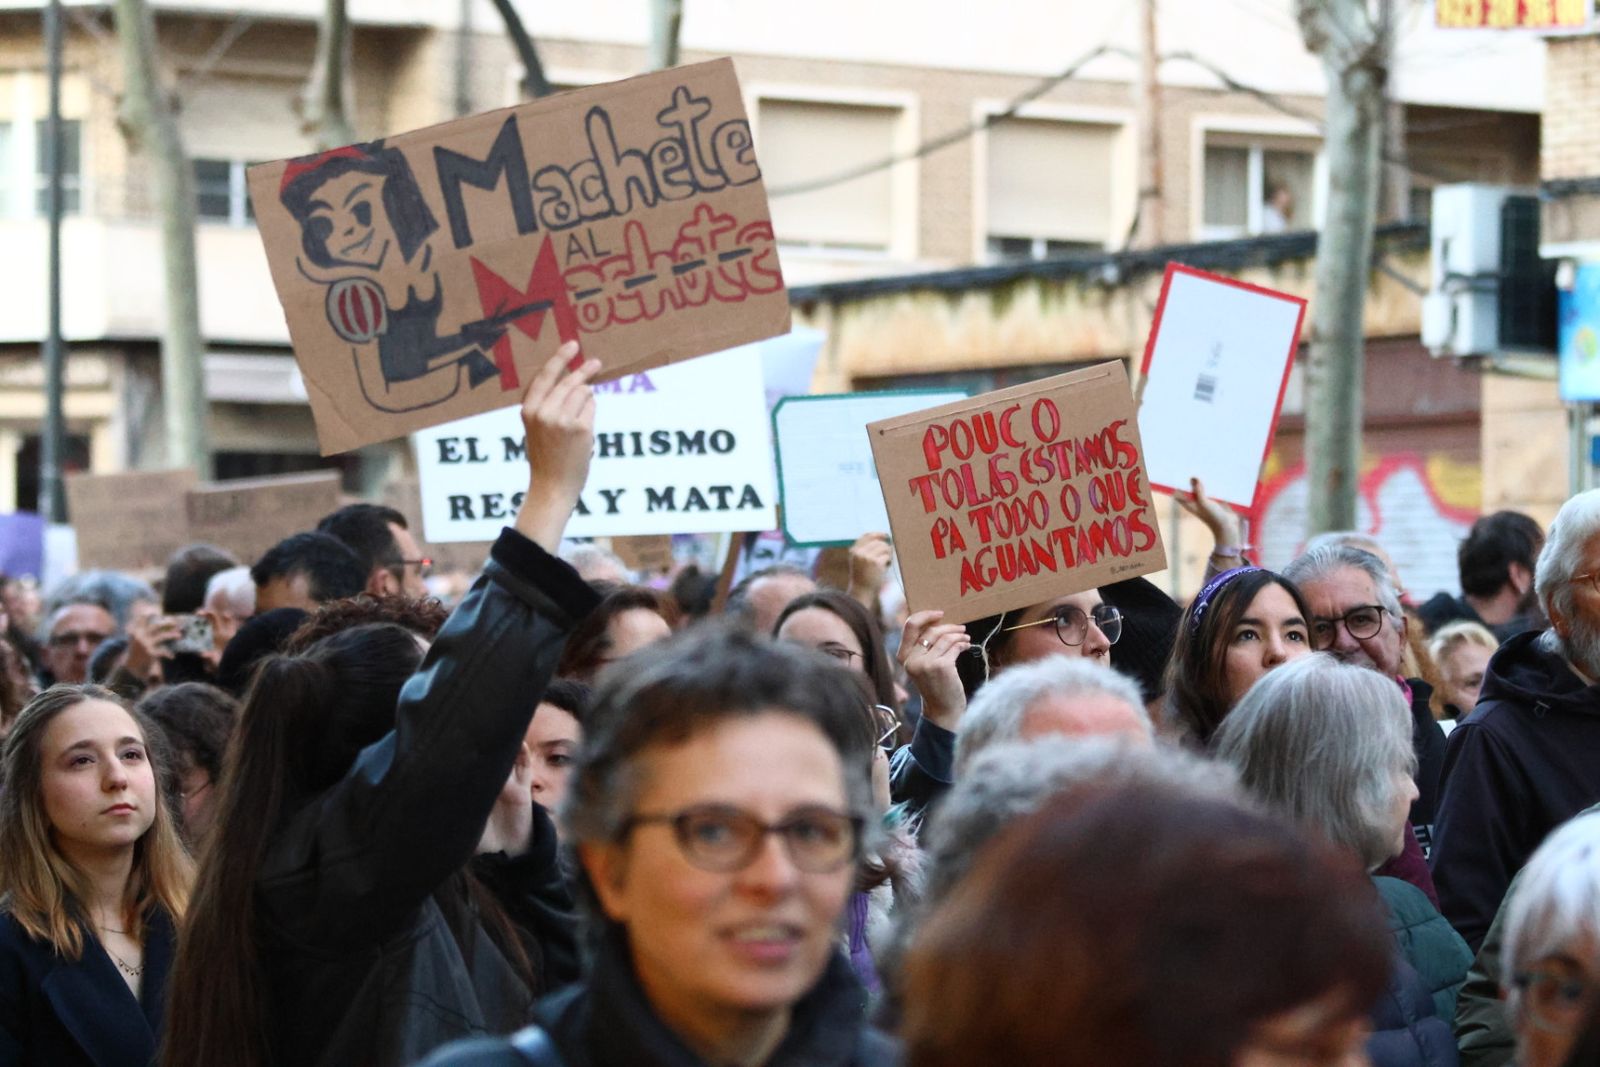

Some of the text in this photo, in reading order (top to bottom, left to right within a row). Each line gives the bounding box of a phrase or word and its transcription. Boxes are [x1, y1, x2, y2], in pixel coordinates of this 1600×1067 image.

[432, 86, 762, 250] Machete
[565, 227, 612, 266] AL
[436, 428, 737, 464] EL MHISMO
[1019, 419, 1139, 486] ESTAMOS
[598, 487, 627, 515] Y
[644, 483, 766, 513] MATA
[929, 466, 1149, 560] PA TODO O QUE
[959, 507, 1157, 598] AGUANTAMOS
